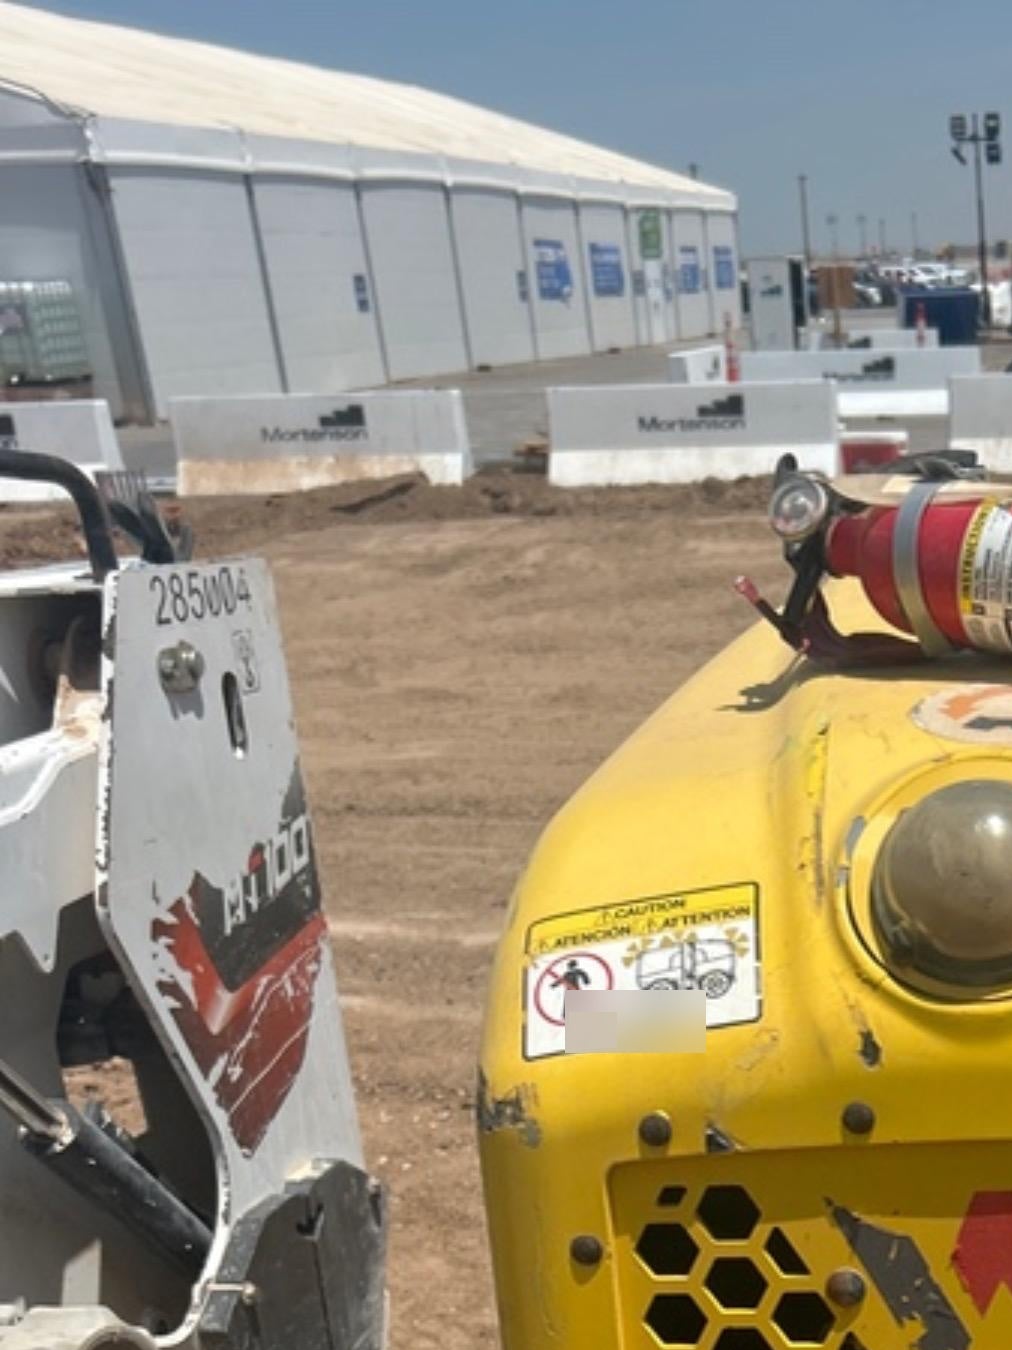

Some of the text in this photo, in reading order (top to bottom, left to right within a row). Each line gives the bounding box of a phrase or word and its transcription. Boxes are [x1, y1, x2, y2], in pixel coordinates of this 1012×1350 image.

[260, 424, 368, 443] Mortenson
[638, 415, 745, 433] Mortenson
[150, 566, 252, 626] 285004
[614, 898, 686, 918] CAUTION
[662, 905, 751, 928] ATTENTION
